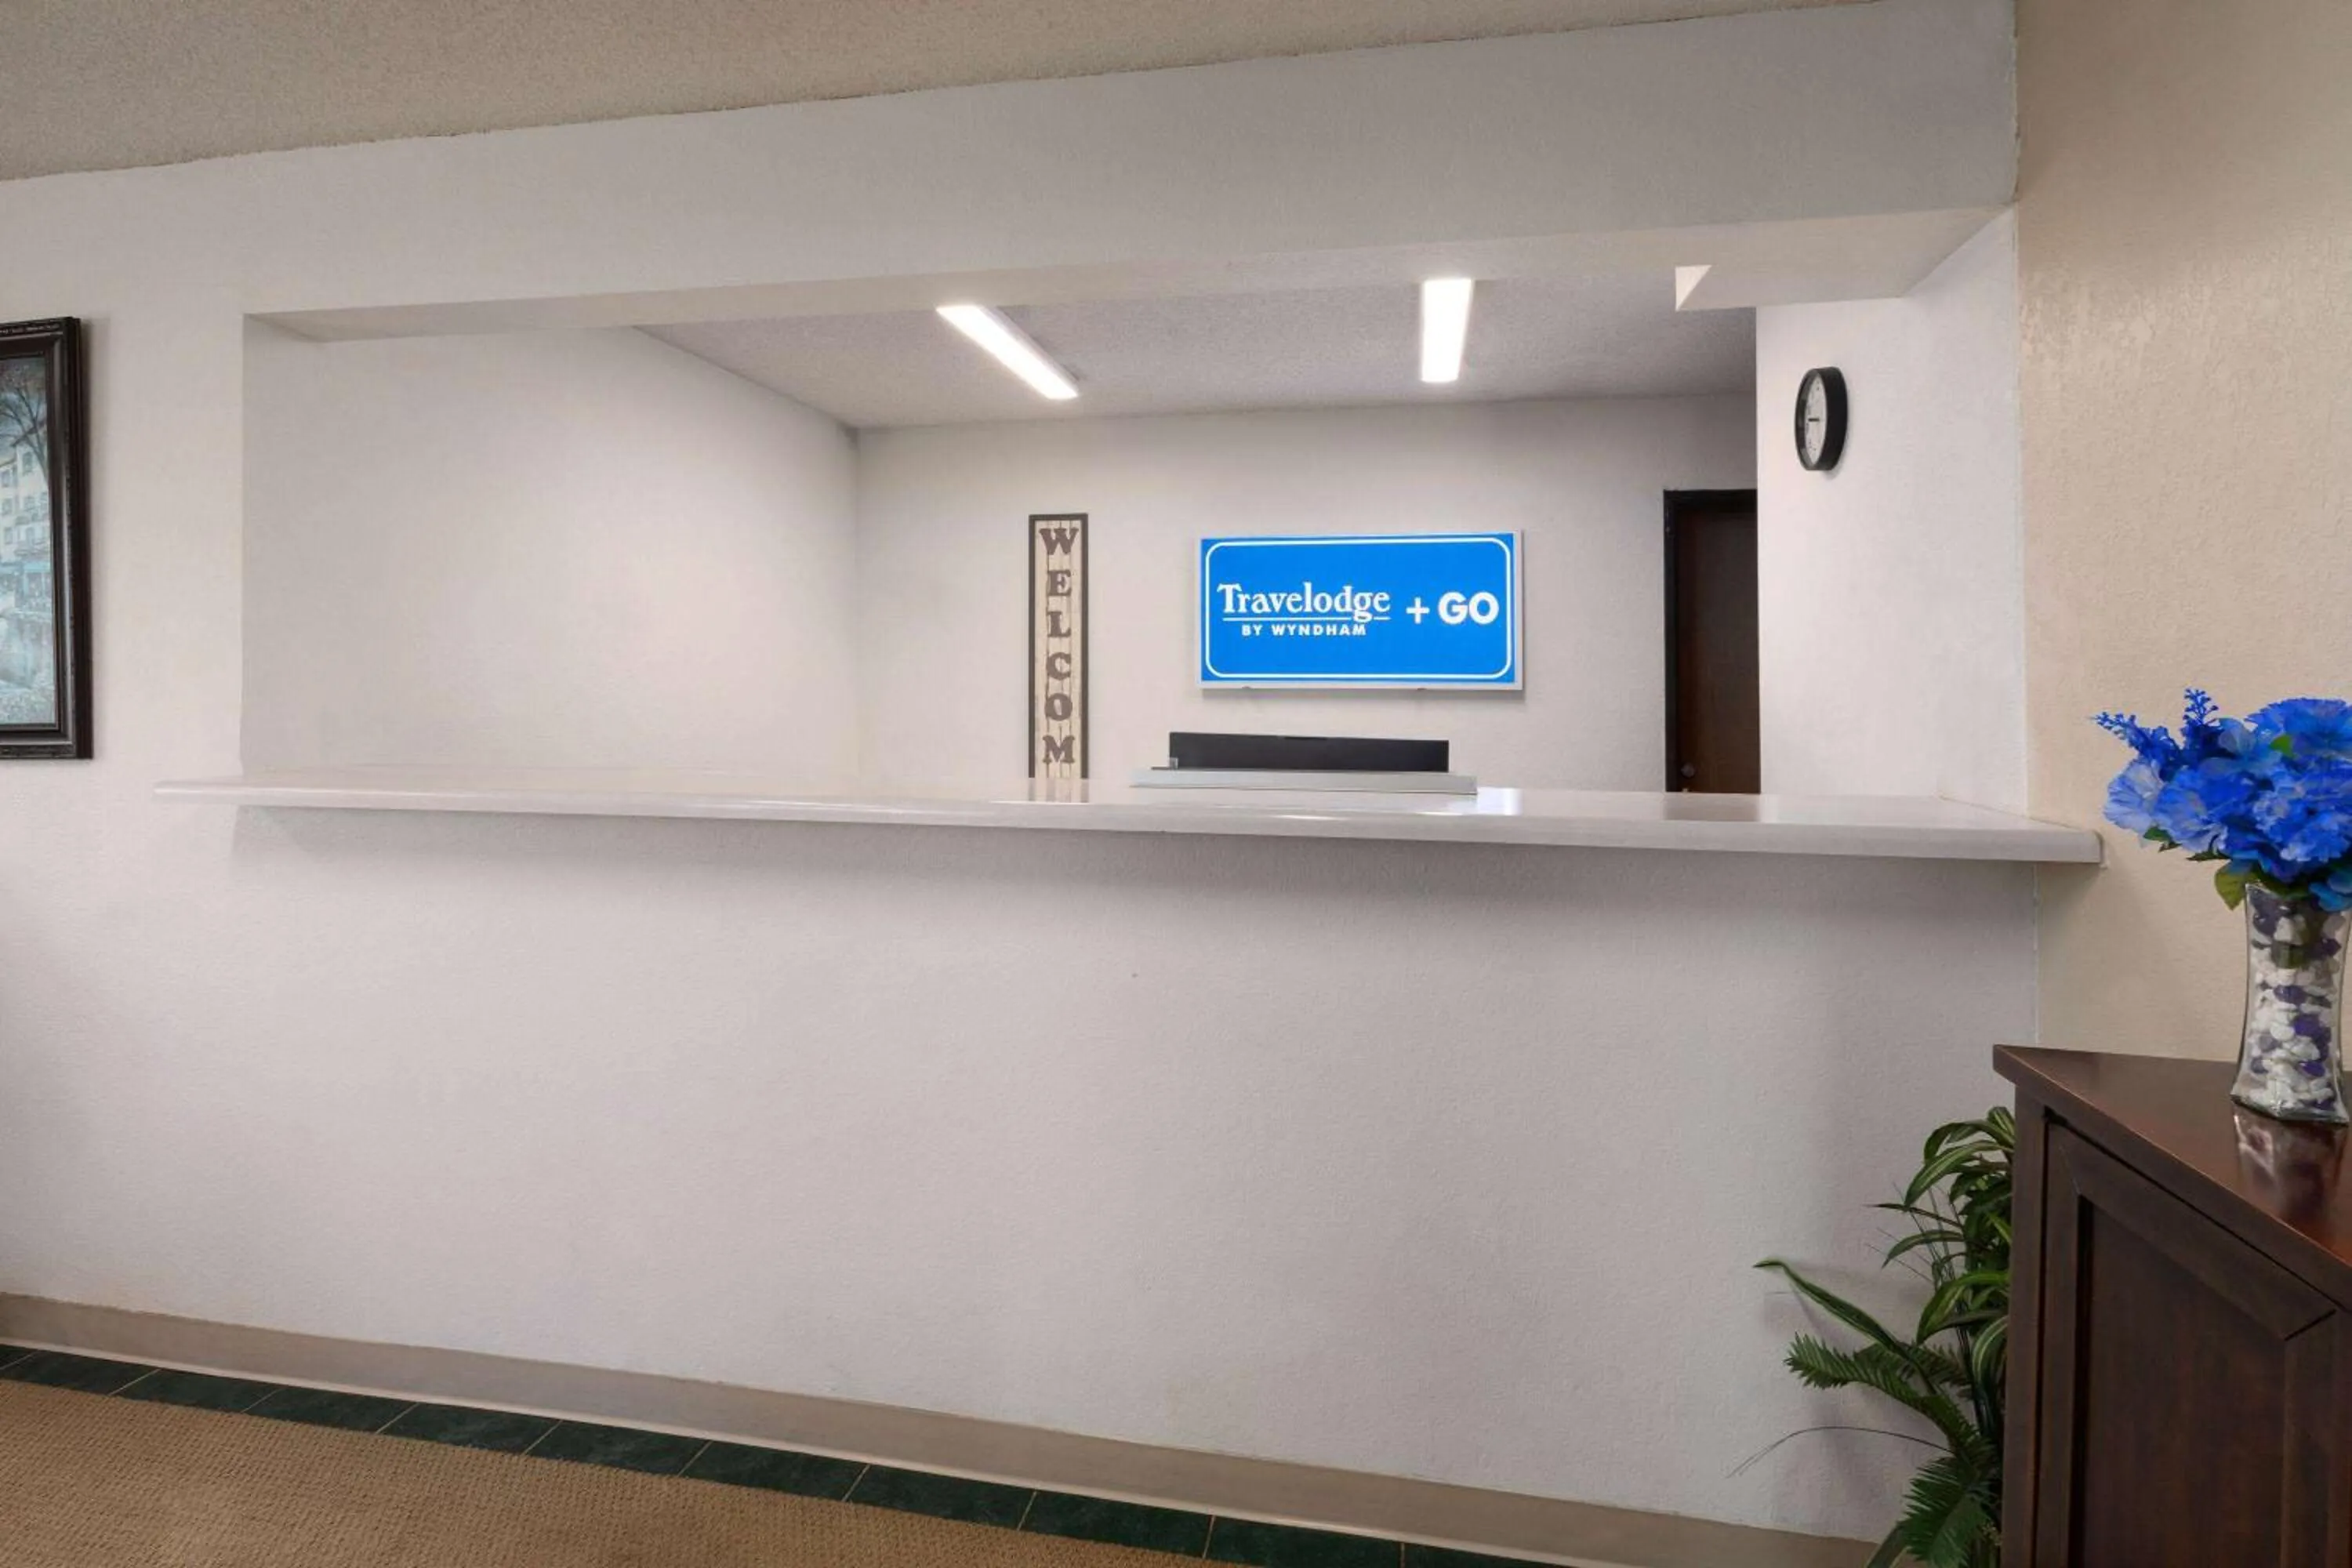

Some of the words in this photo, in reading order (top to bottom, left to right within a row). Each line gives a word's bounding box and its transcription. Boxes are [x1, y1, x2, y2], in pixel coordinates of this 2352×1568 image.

[1217, 581, 1391, 623] Travelodge
[1438, 592, 1499, 625] GO
[1039, 527, 1079, 764] WELCOM
[1241, 623, 1263, 637] BY
[1272, 623, 1367, 637] WYNDHAM
